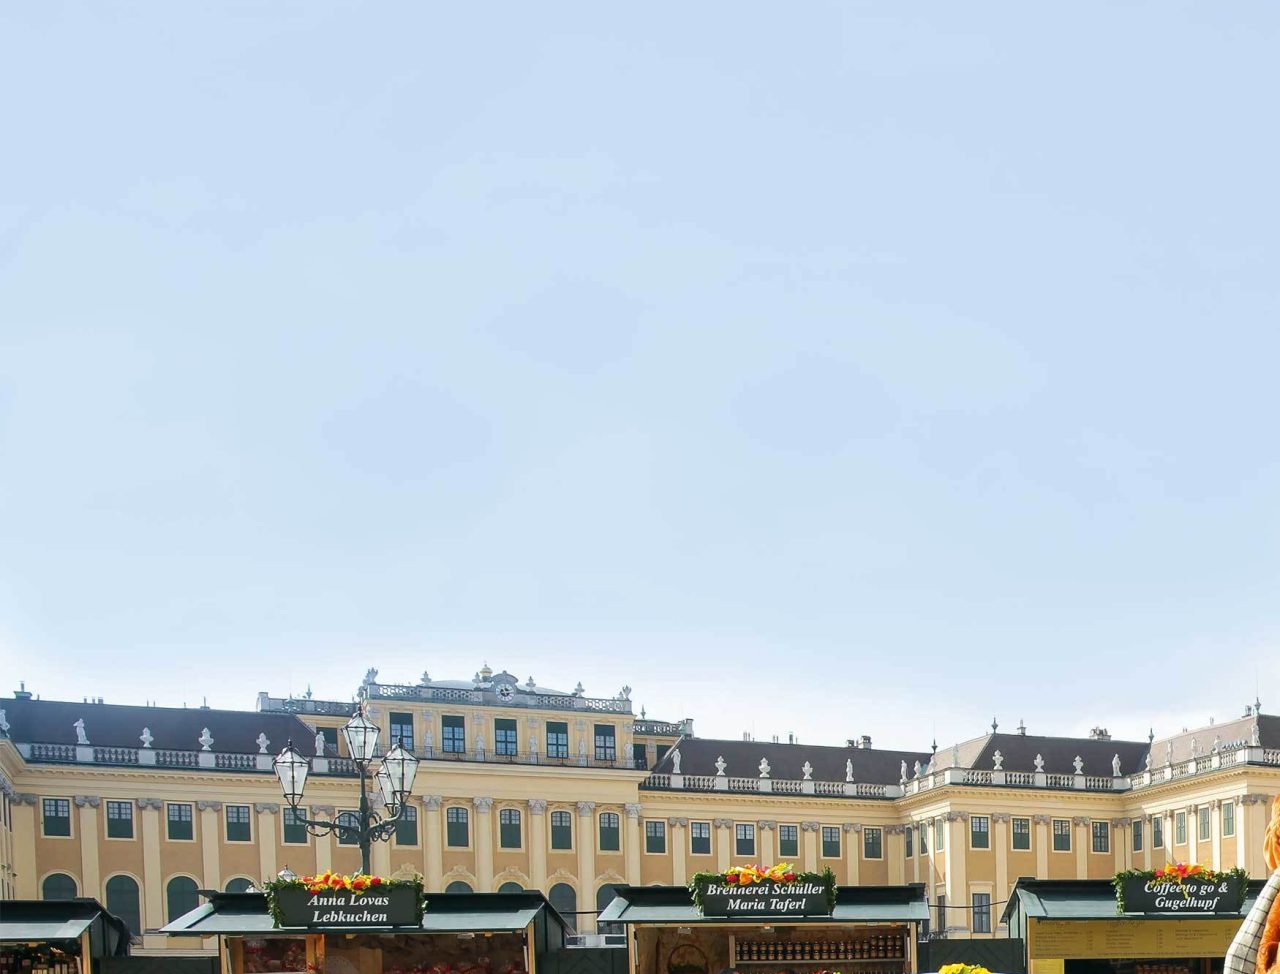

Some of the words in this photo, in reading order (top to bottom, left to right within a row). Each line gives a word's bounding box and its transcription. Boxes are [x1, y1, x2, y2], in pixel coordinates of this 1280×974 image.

[706, 884, 769, 895] Brennerei
[772, 883, 825, 895] Schüller
[1144, 882, 1183, 895] Coffee
[1185, 883, 1197, 893] to
[1200, 884, 1215, 895] go
[1218, 882, 1228, 893] &
[307, 894, 346, 906] Anna
[349, 894, 389, 906] Lovas
[726, 898, 766, 910] Maria
[770, 898, 807, 912] Taferl
[1155, 896, 1220, 910] Gugelhupf
[312, 910, 388, 922] Lebkuchen
